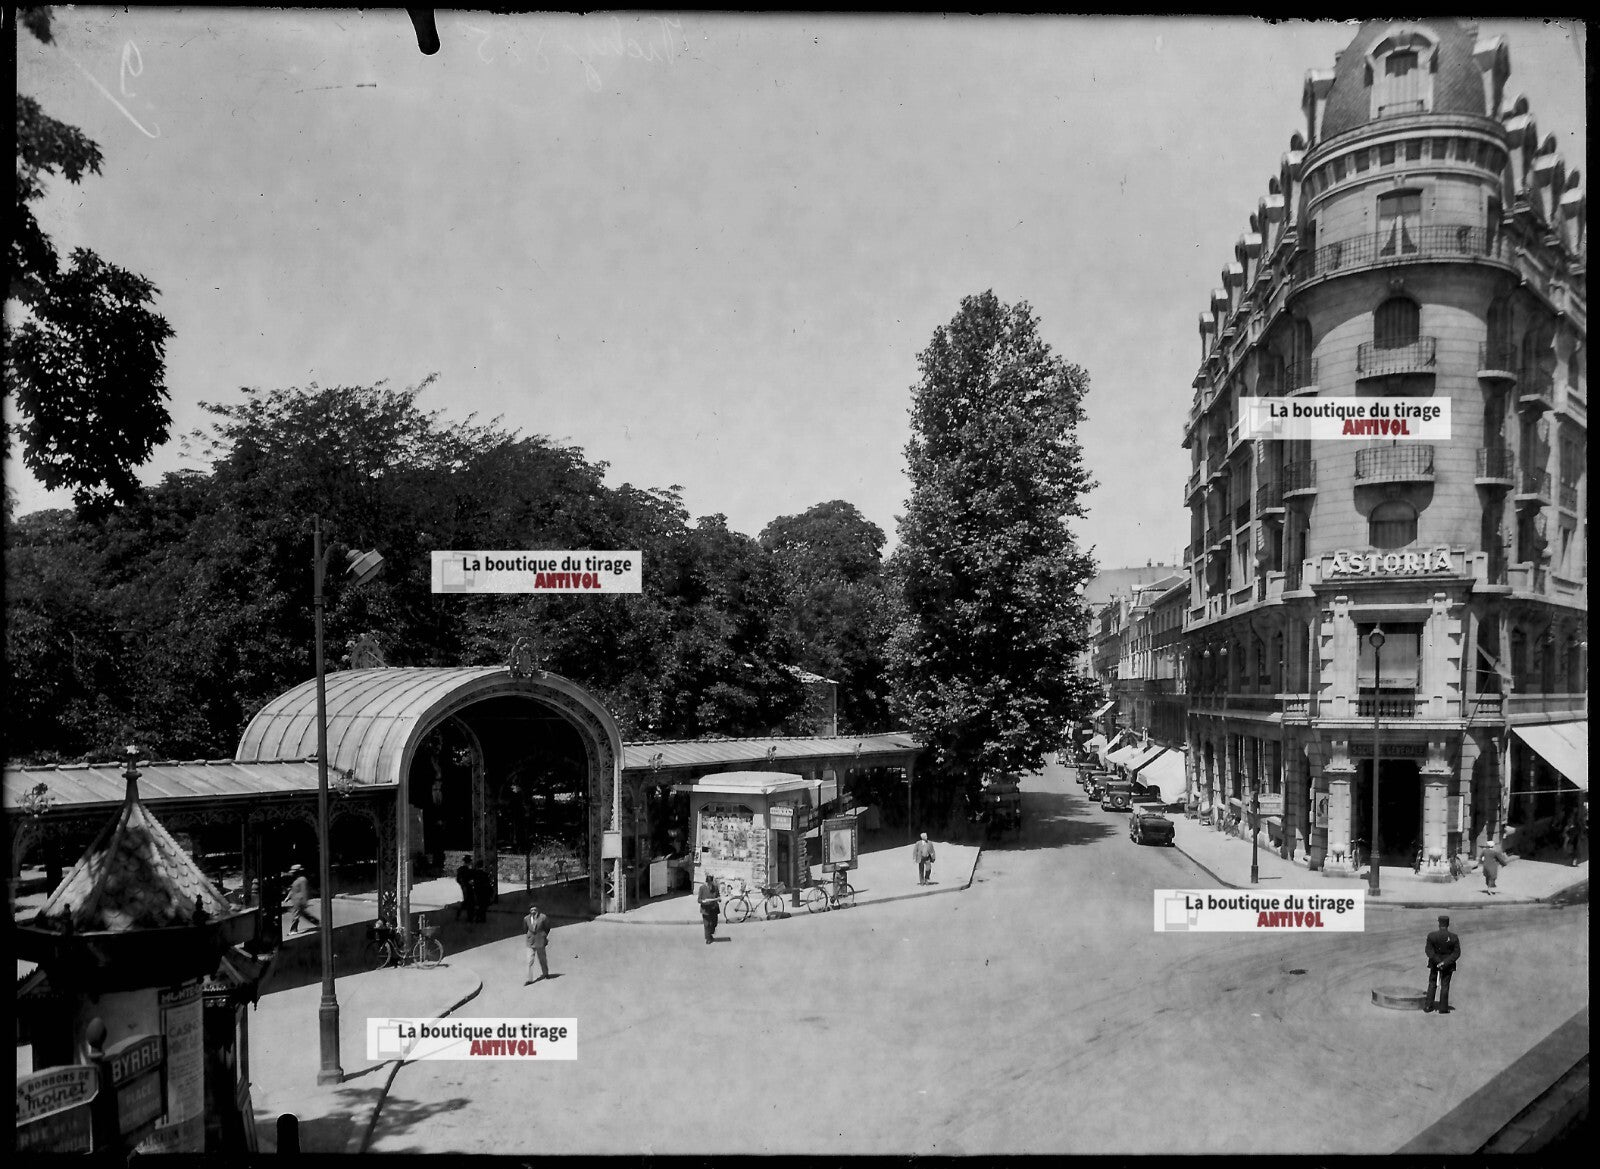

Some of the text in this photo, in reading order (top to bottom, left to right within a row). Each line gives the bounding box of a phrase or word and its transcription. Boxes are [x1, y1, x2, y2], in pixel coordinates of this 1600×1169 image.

[1328, 550, 1454, 575] ASTORIA
[112, 1038, 161, 1083] BYRRH
[28, 1072, 75, 1092] BONBONS
